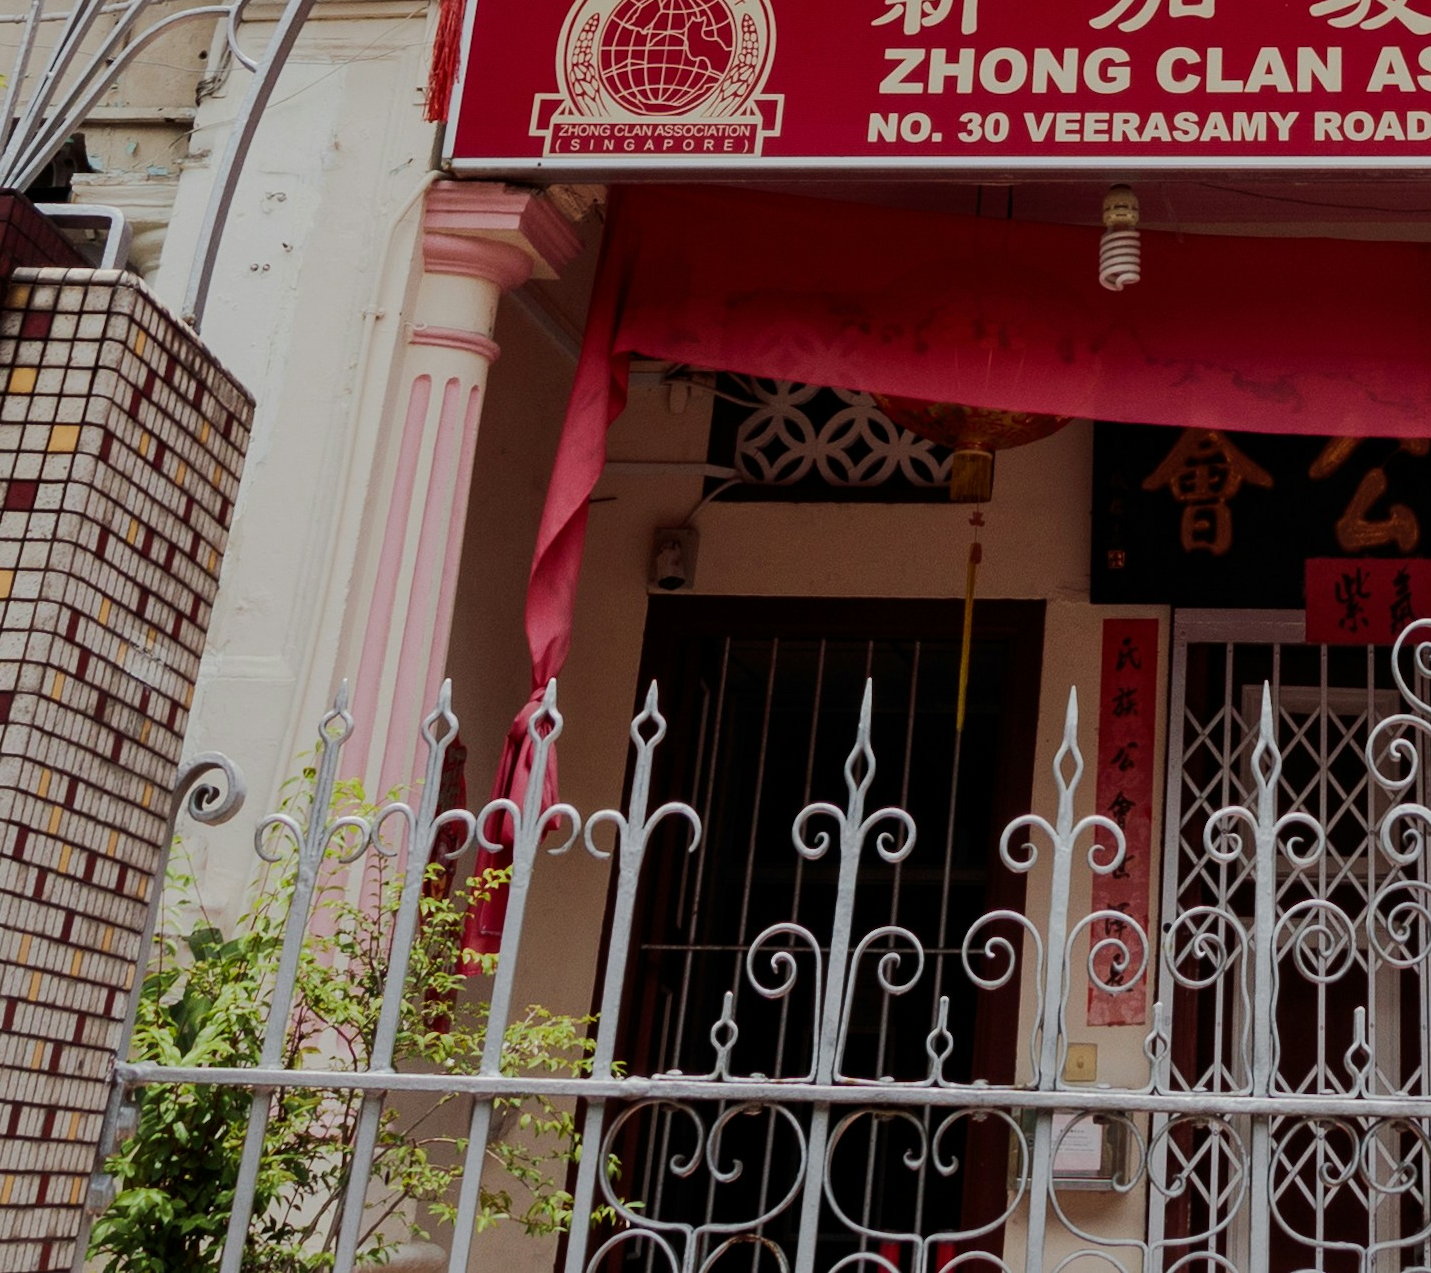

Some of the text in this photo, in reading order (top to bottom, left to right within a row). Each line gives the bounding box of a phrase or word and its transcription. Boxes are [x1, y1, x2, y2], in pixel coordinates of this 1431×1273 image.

[879, 47, 1132, 95] ZHONG
[1155, 47, 1343, 93] CLAN
[559, 124, 750, 137] ZHONG CLAN ASSOCIATION
[868, 112, 943, 143] NO.
[957, 112, 1010, 142] 30
[1023, 111, 1300, 142] VEERASAMY
